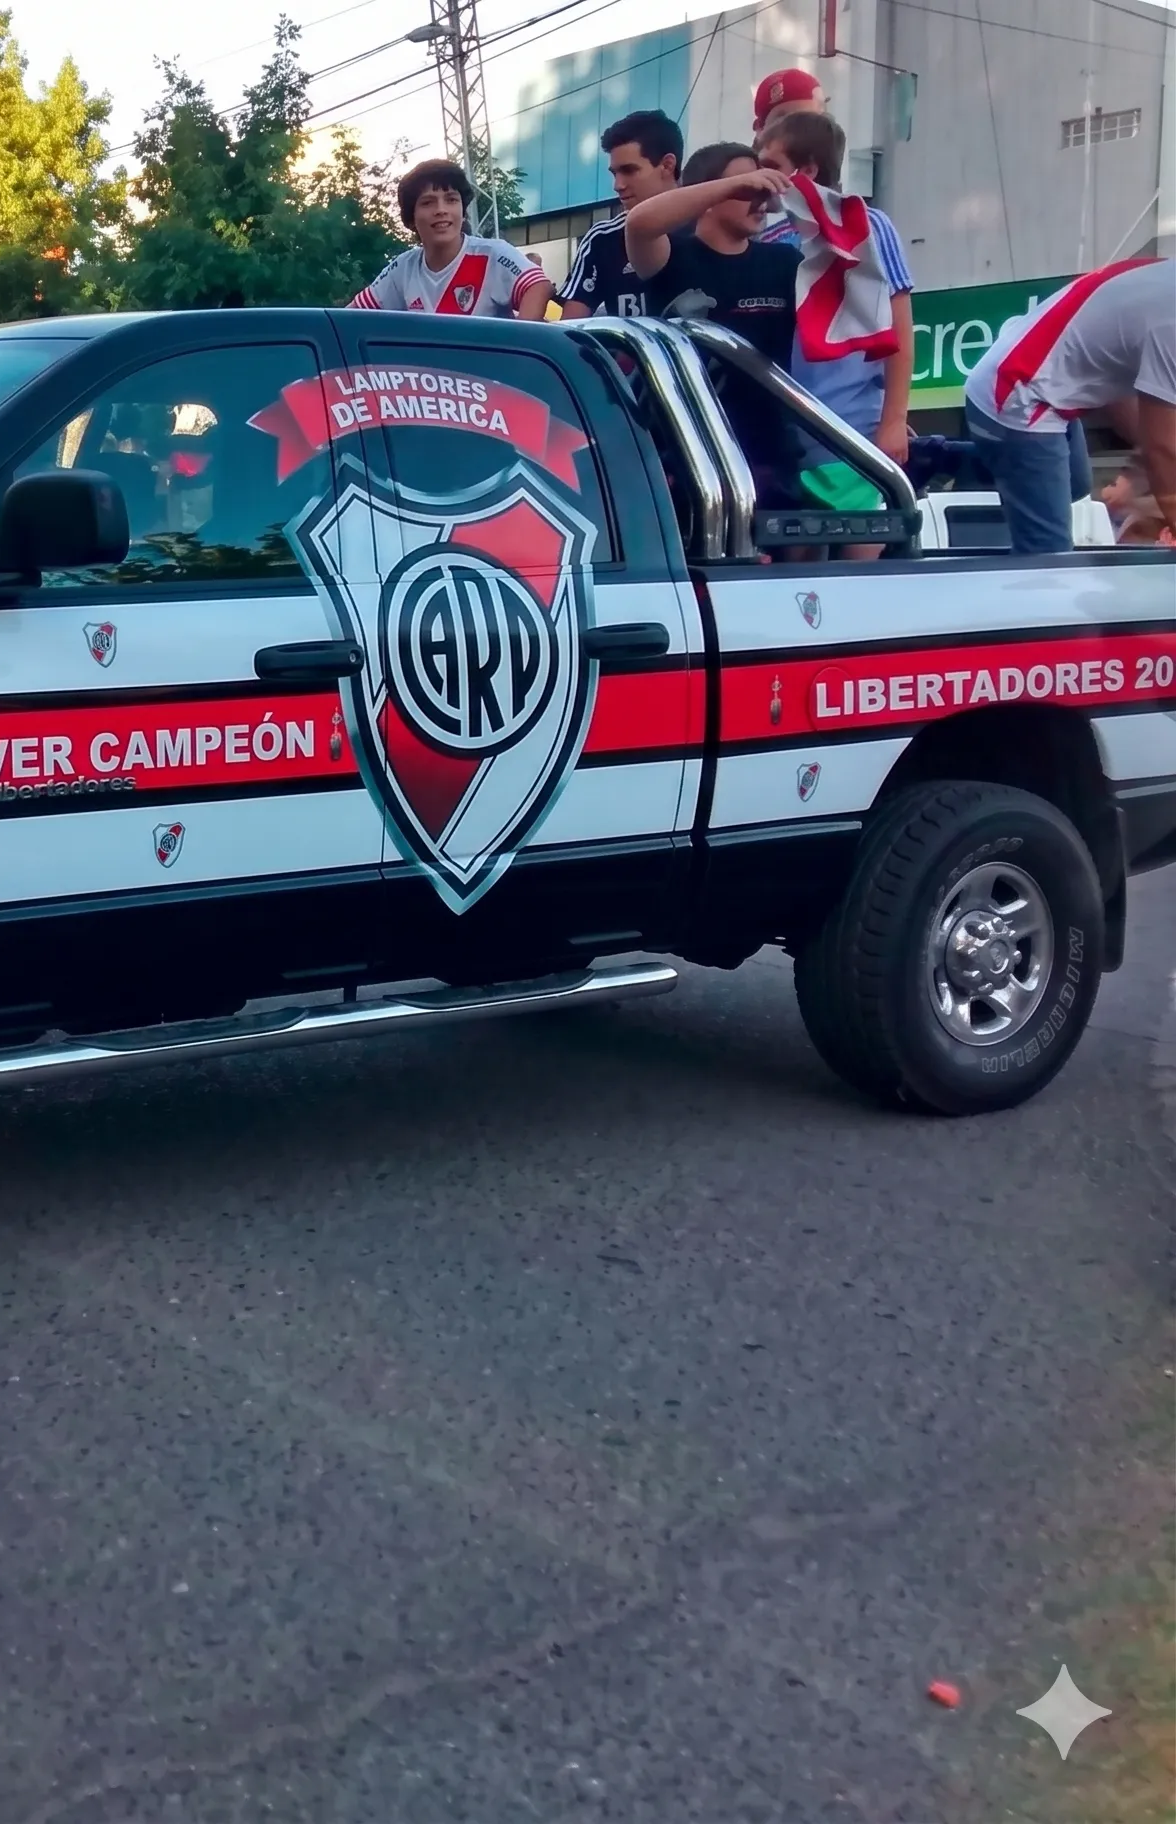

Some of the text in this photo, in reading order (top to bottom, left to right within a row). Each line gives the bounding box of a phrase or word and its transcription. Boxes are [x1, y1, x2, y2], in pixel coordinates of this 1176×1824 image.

[334, 370, 488, 402] LAMPTORES
[330, 395, 510, 436] DE AMERICA
[816, 655, 1174, 718] LIBERTADORES 20
[89, 711, 315, 772] CAMPEÓN
